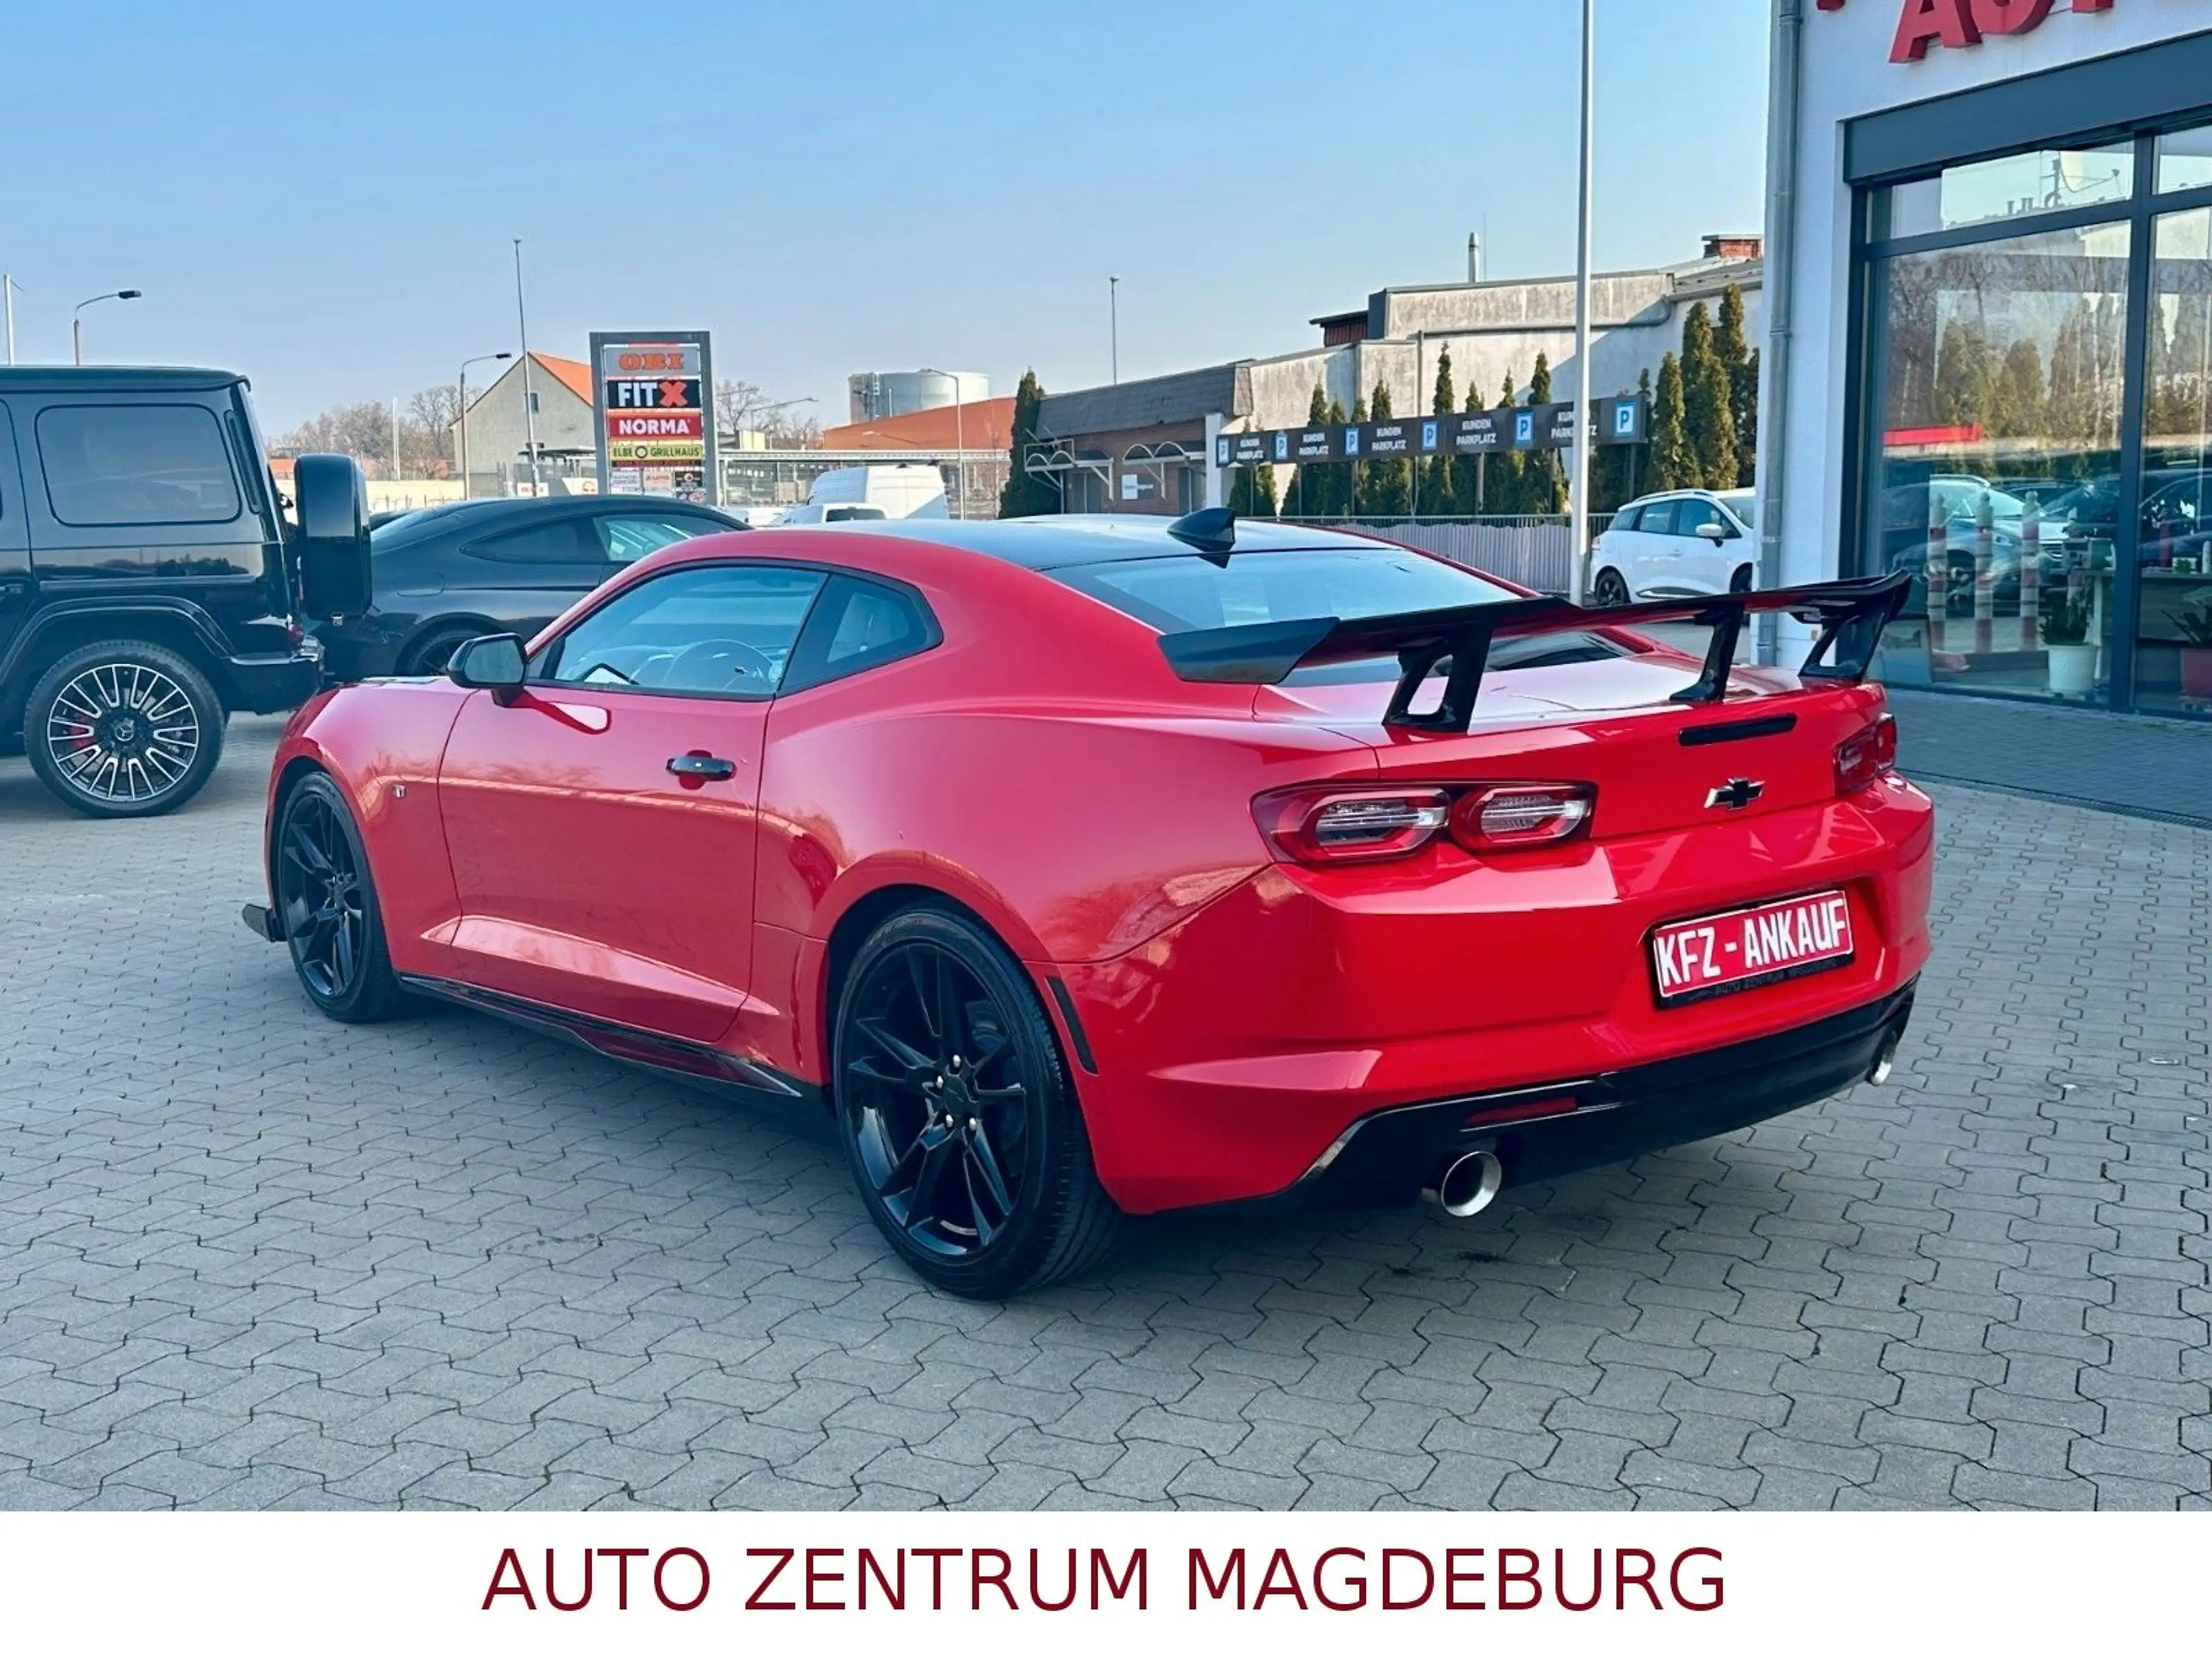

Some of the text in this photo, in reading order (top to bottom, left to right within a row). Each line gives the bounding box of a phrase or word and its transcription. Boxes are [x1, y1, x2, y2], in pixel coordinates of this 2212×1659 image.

[619, 353, 684, 370] OBI
[618, 381, 688, 407] FITX
[619, 419, 690, 435] NORMA
[1462, 418, 1491, 430] KUNDEN
[1372, 440, 1406, 451] PARKPLATZ
[1456, 433, 1497, 446] PARKPLATZ
[613, 448, 699, 457] ELBE GRILLHAUS
